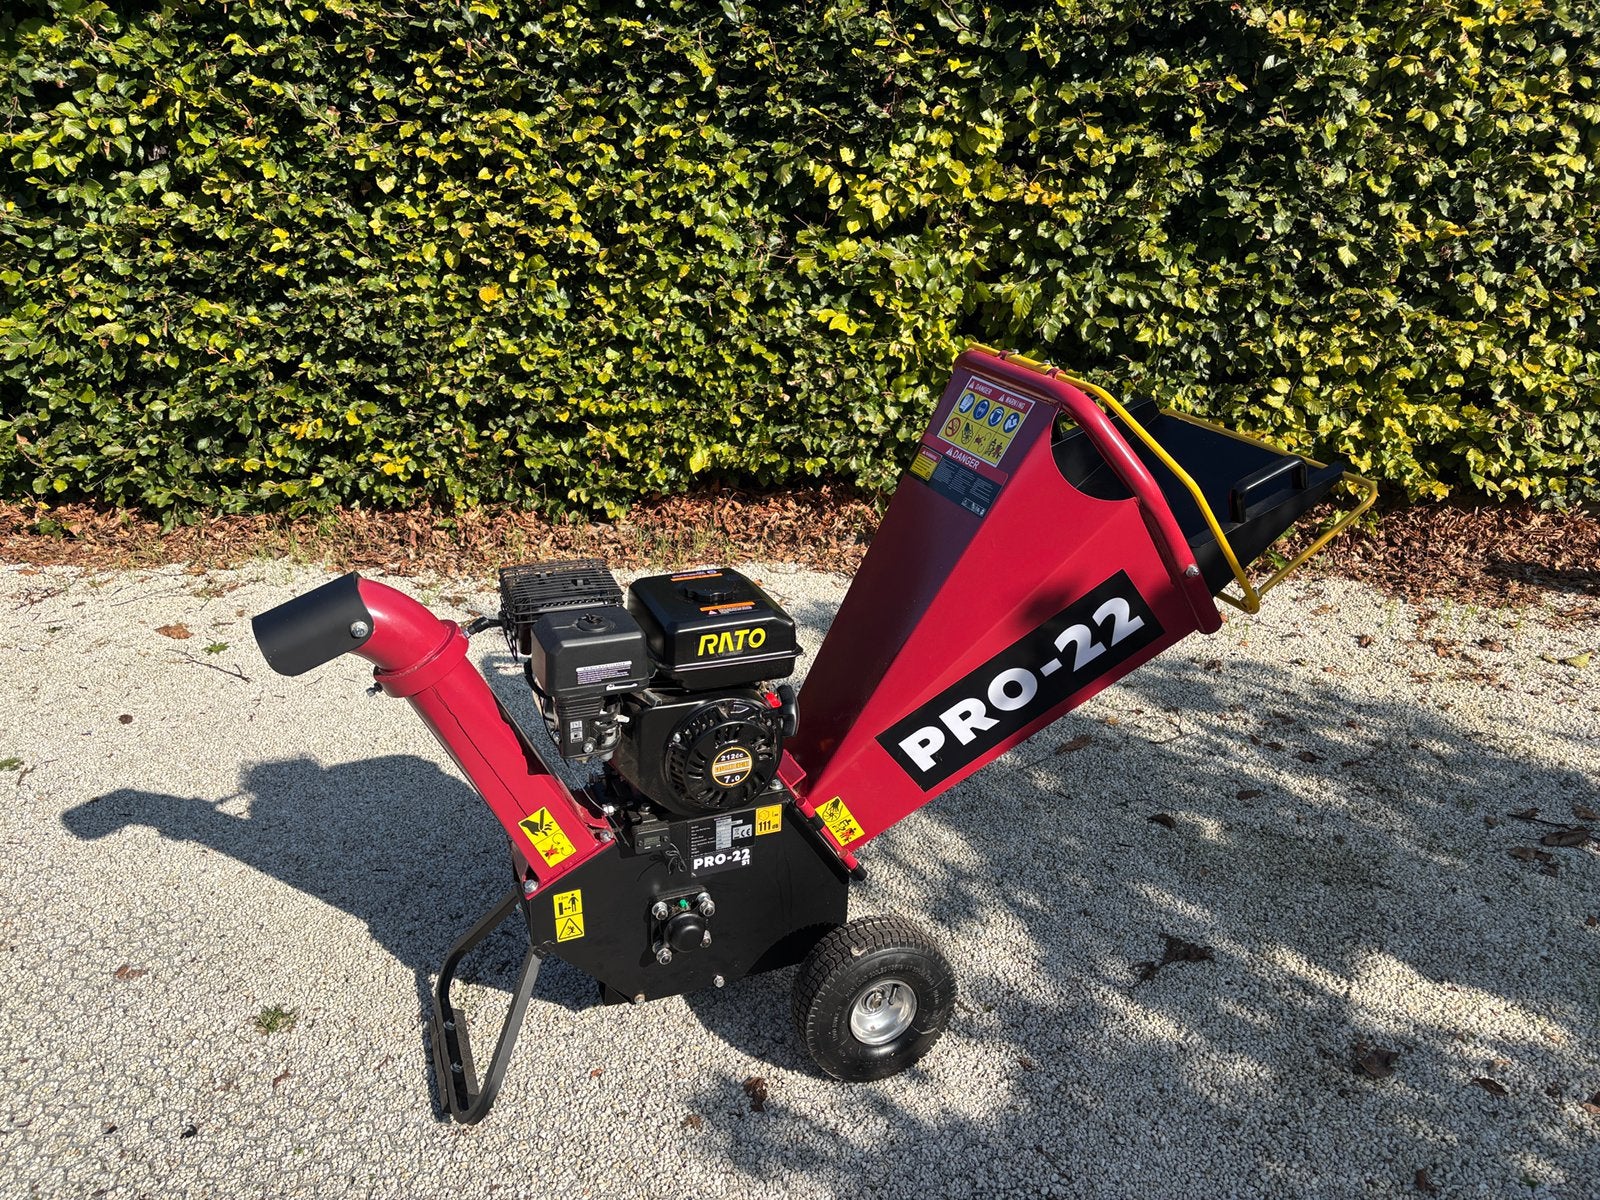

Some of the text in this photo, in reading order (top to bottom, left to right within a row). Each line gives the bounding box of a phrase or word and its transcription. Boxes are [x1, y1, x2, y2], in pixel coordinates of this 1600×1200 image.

[951, 450, 980, 470] DANGER
[697, 627, 767, 657] RATO
[898, 597, 1145, 772] PRO-22
[723, 774, 741, 784] 7.0
[758, 820, 771, 832] 111
[693, 848, 751, 870] PRO-22
